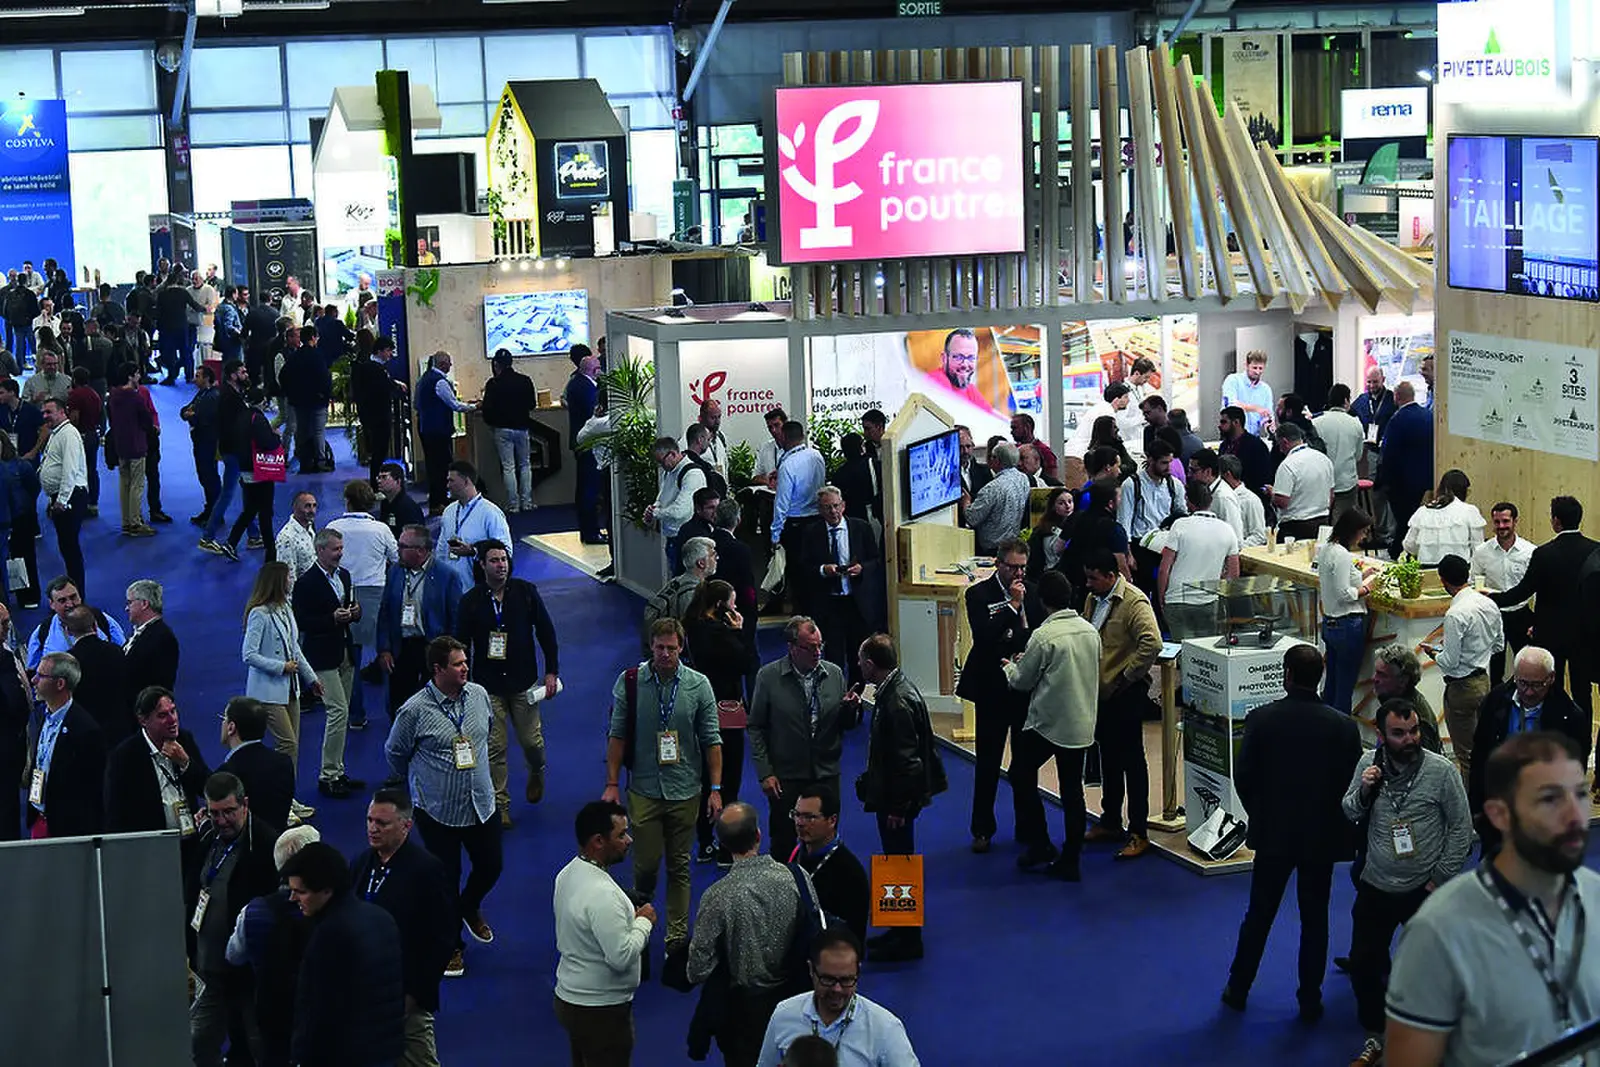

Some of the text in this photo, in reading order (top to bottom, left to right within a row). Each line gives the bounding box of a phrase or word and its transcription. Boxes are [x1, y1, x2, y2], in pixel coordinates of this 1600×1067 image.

[899, 3, 940, 15] SORTIE
[1443, 58, 1551, 77] PIVETEAUBOIS
[1371, 103, 1412, 117] rema
[5, 138, 55, 148] COSYLVA
[879, 152, 1002, 185] france
[1460, 199, 1584, 233] TAILLAGE
[773, 274, 793, 300] LC
[1569, 368, 1578, 384] 3
[727, 388, 775, 400] france
[811, 384, 867, 398] Industriel
[1562, 384, 1587, 397] SITES
[812, 400, 882, 413] de solutions
